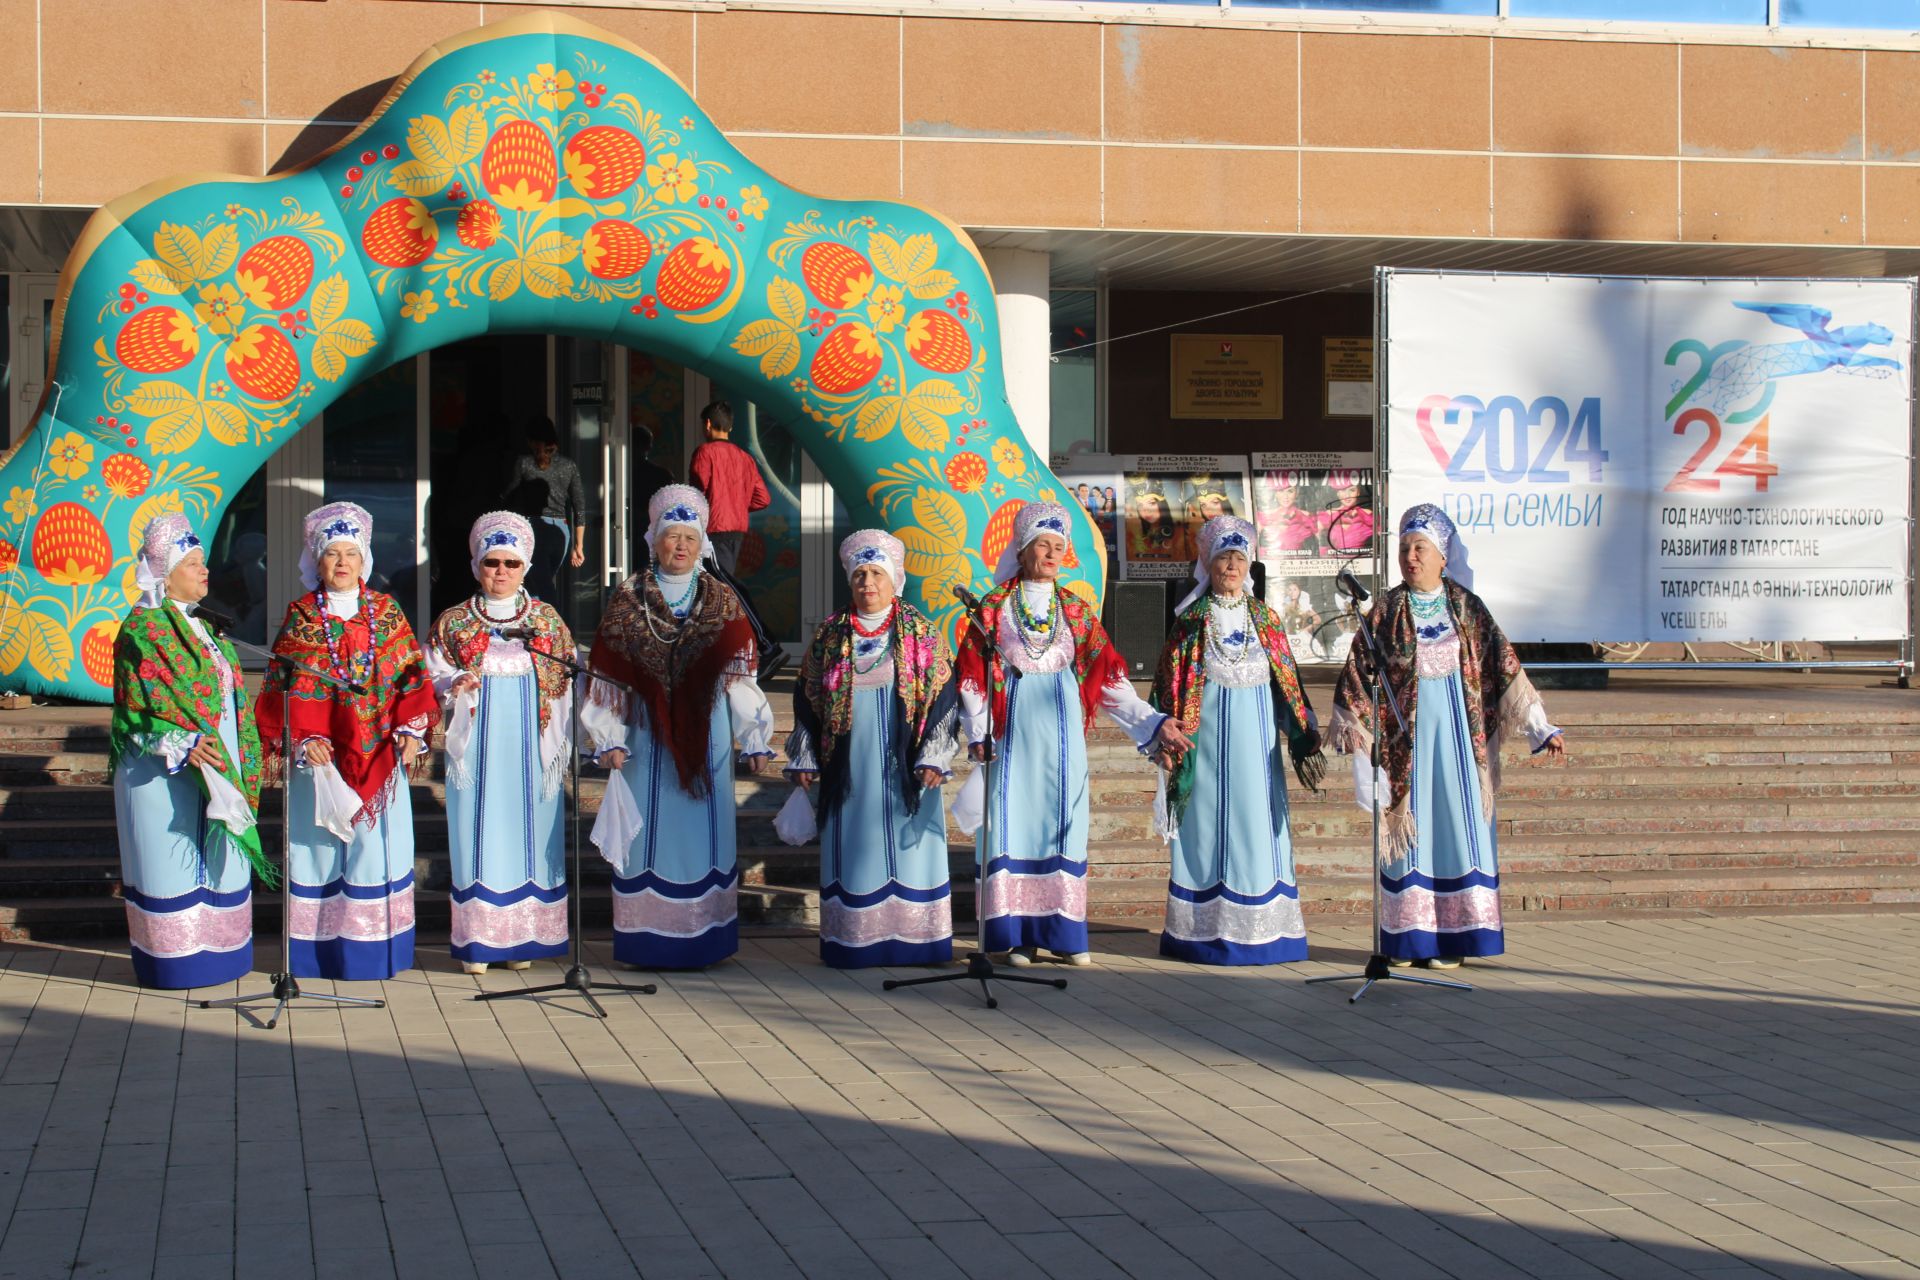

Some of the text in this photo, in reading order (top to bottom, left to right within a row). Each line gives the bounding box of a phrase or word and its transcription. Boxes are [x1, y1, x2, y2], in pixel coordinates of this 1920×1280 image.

[572, 386, 602, 400] ВЫХОД
[1444, 394, 1609, 484] 2024
[1663, 407, 1779, 493] 24
[1662, 507, 1884, 528] ГОД НАУЧНО-ТЕХНОЛОГИЧЕСКОГО
[1661, 539, 1820, 556] РАЗВИТИЯ В ТАТАРСТАНЕ
[1661, 579, 1893, 600] ТАТАРСТАНДА ФӘННИ-ТЕХНОЛОГИК
[1700, 611, 1727, 629] ЕЛЫ
